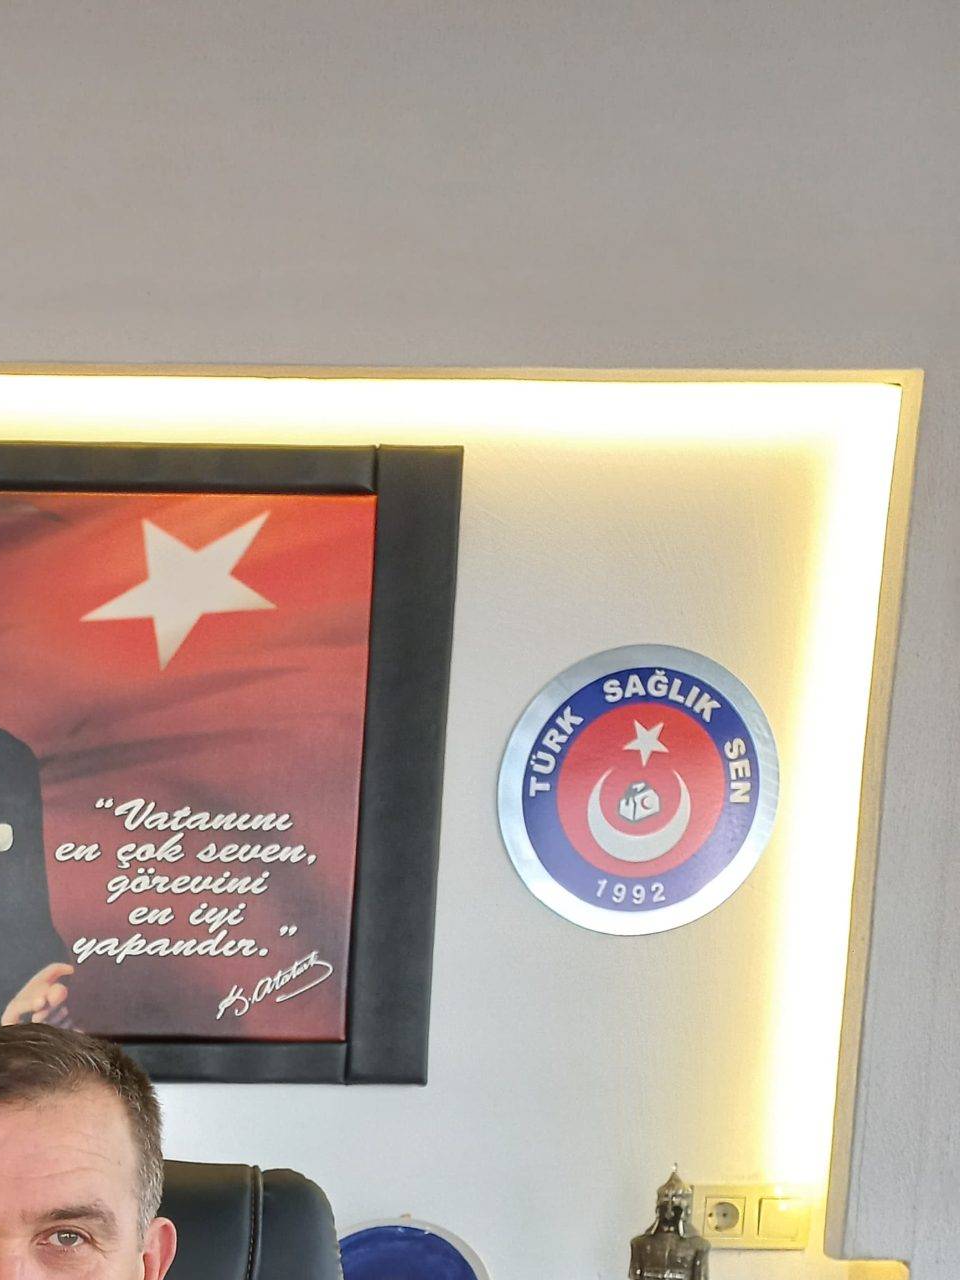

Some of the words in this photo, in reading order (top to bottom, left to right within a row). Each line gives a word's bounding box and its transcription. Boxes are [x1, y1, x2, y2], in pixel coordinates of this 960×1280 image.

[529, 705, 584, 798] TÜRK
[602, 669, 722, 722] SAĞLIK
[723, 737, 752, 804] SEN
[54, 842, 102, 862] en
[116, 832, 186, 869] çok
[106, 867, 271, 904] görevini
[596, 878, 666, 905] 1992
[128, 905, 175, 926] en
[189, 902, 247, 933] iyi
